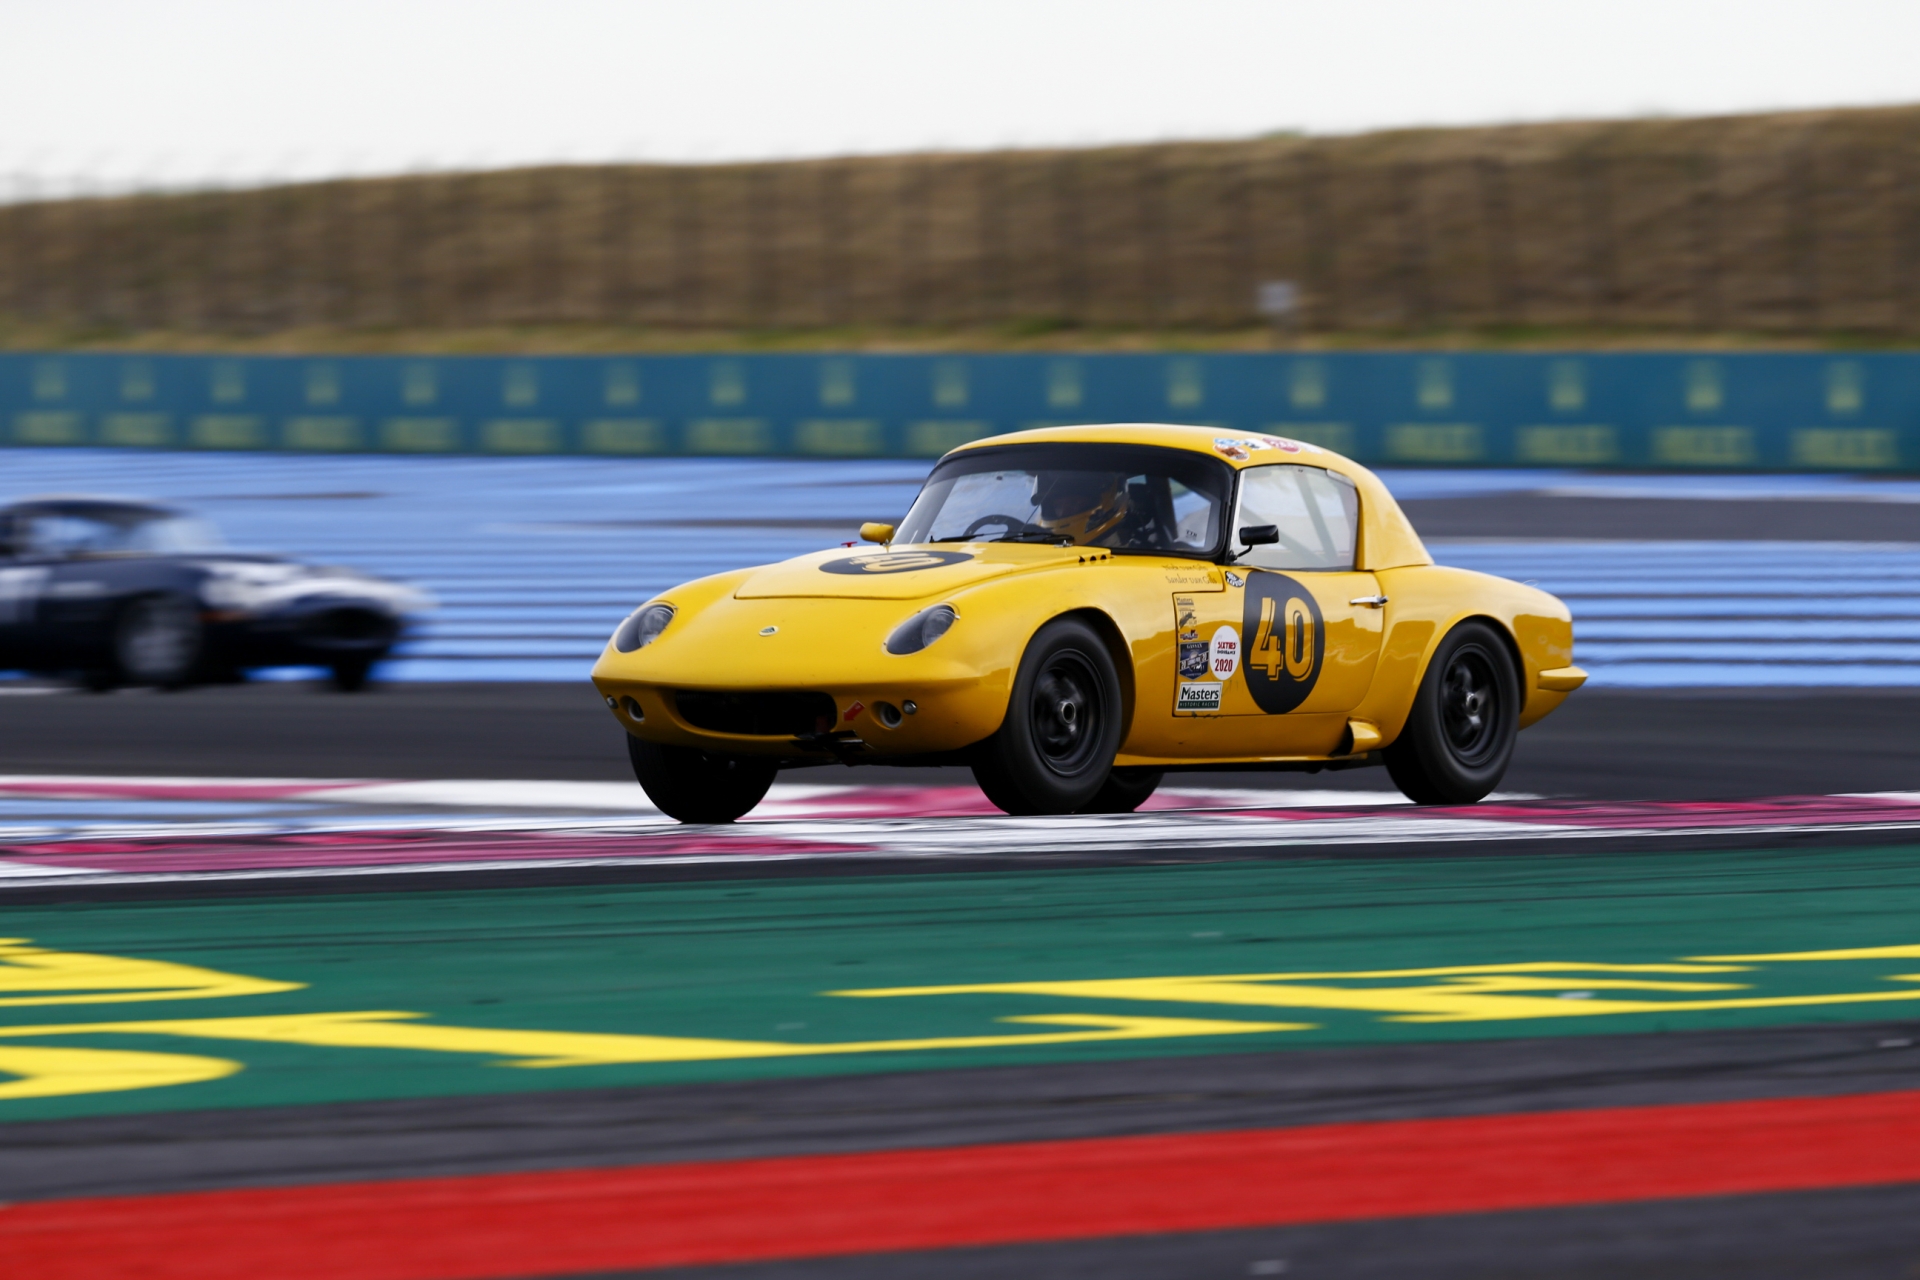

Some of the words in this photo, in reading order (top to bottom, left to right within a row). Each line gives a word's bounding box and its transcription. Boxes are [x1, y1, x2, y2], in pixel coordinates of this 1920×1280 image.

[1250, 597, 1315, 682] 40
[1214, 658, 1233, 672] 2020
[1181, 686, 1220, 700] Masters
